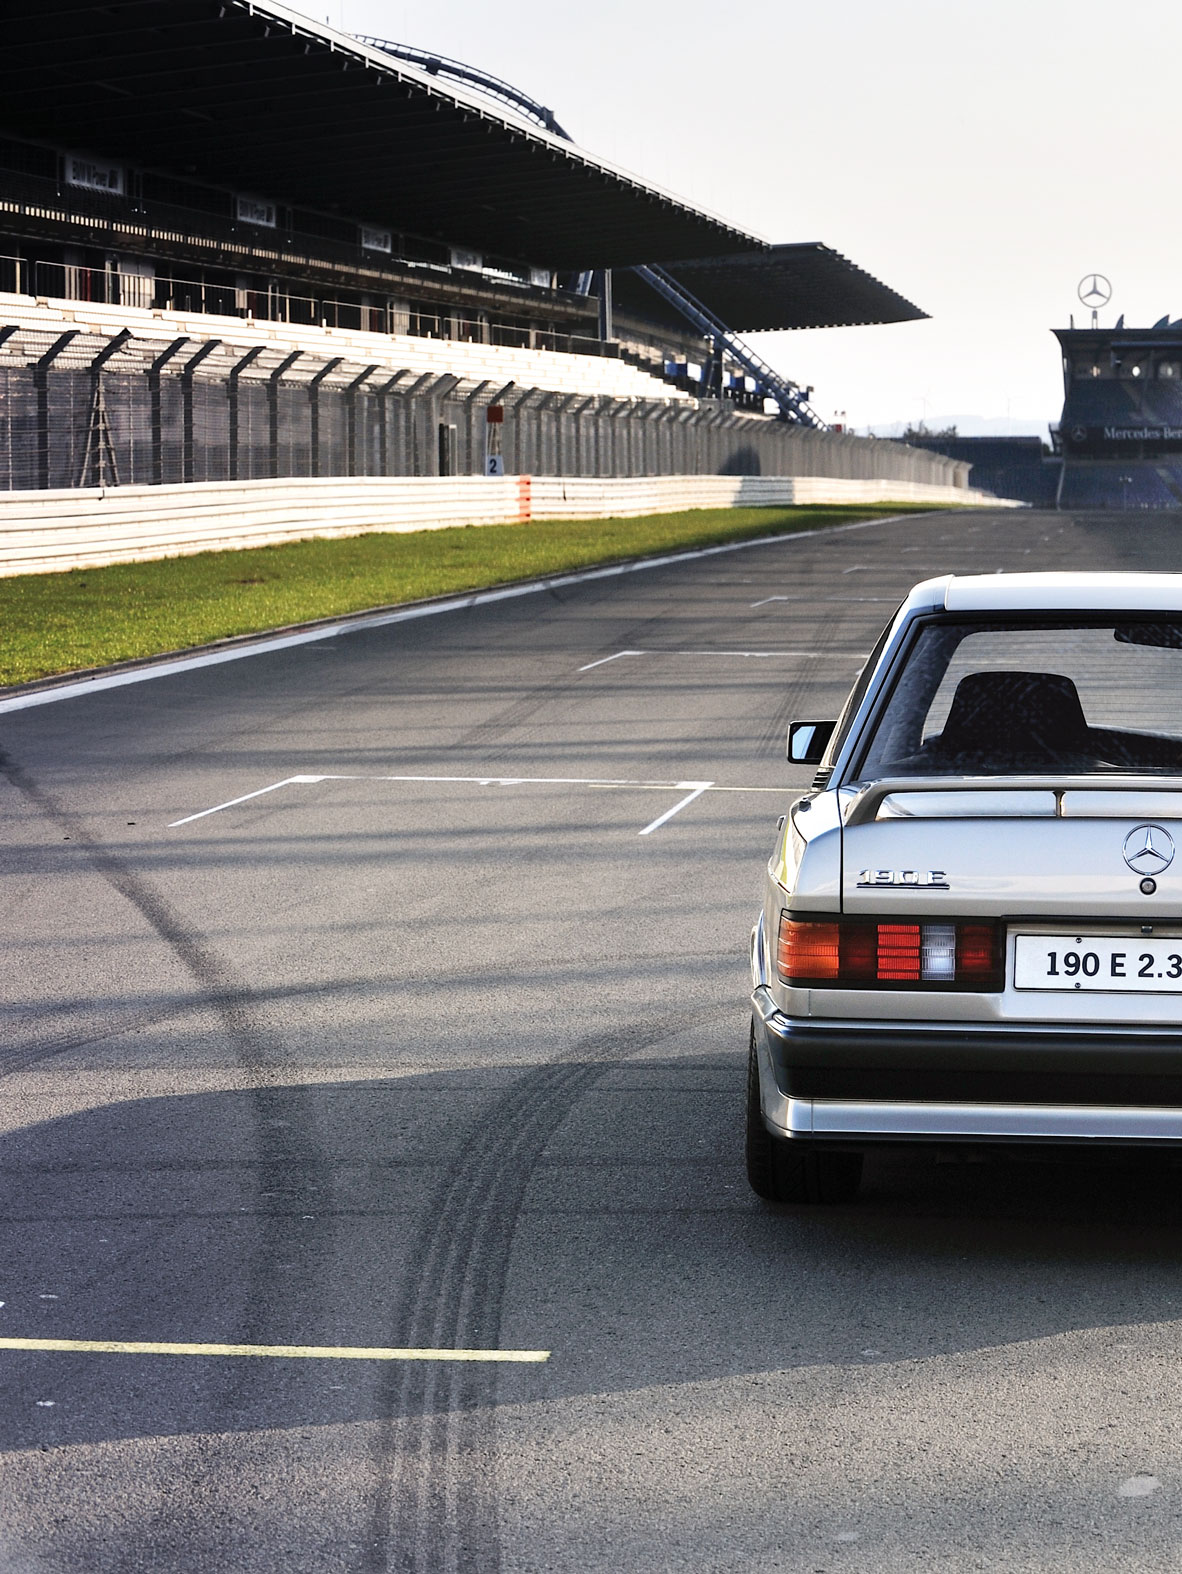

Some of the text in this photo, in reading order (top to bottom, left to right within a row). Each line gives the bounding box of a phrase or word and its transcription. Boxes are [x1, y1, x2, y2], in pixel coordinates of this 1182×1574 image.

[490, 459, 497, 473] 2
[860, 869, 919, 884] 190
[1046, 952, 1100, 976] 190
[1110, 953, 1127, 977] E
[1138, 954, 1182, 979] 2.3
